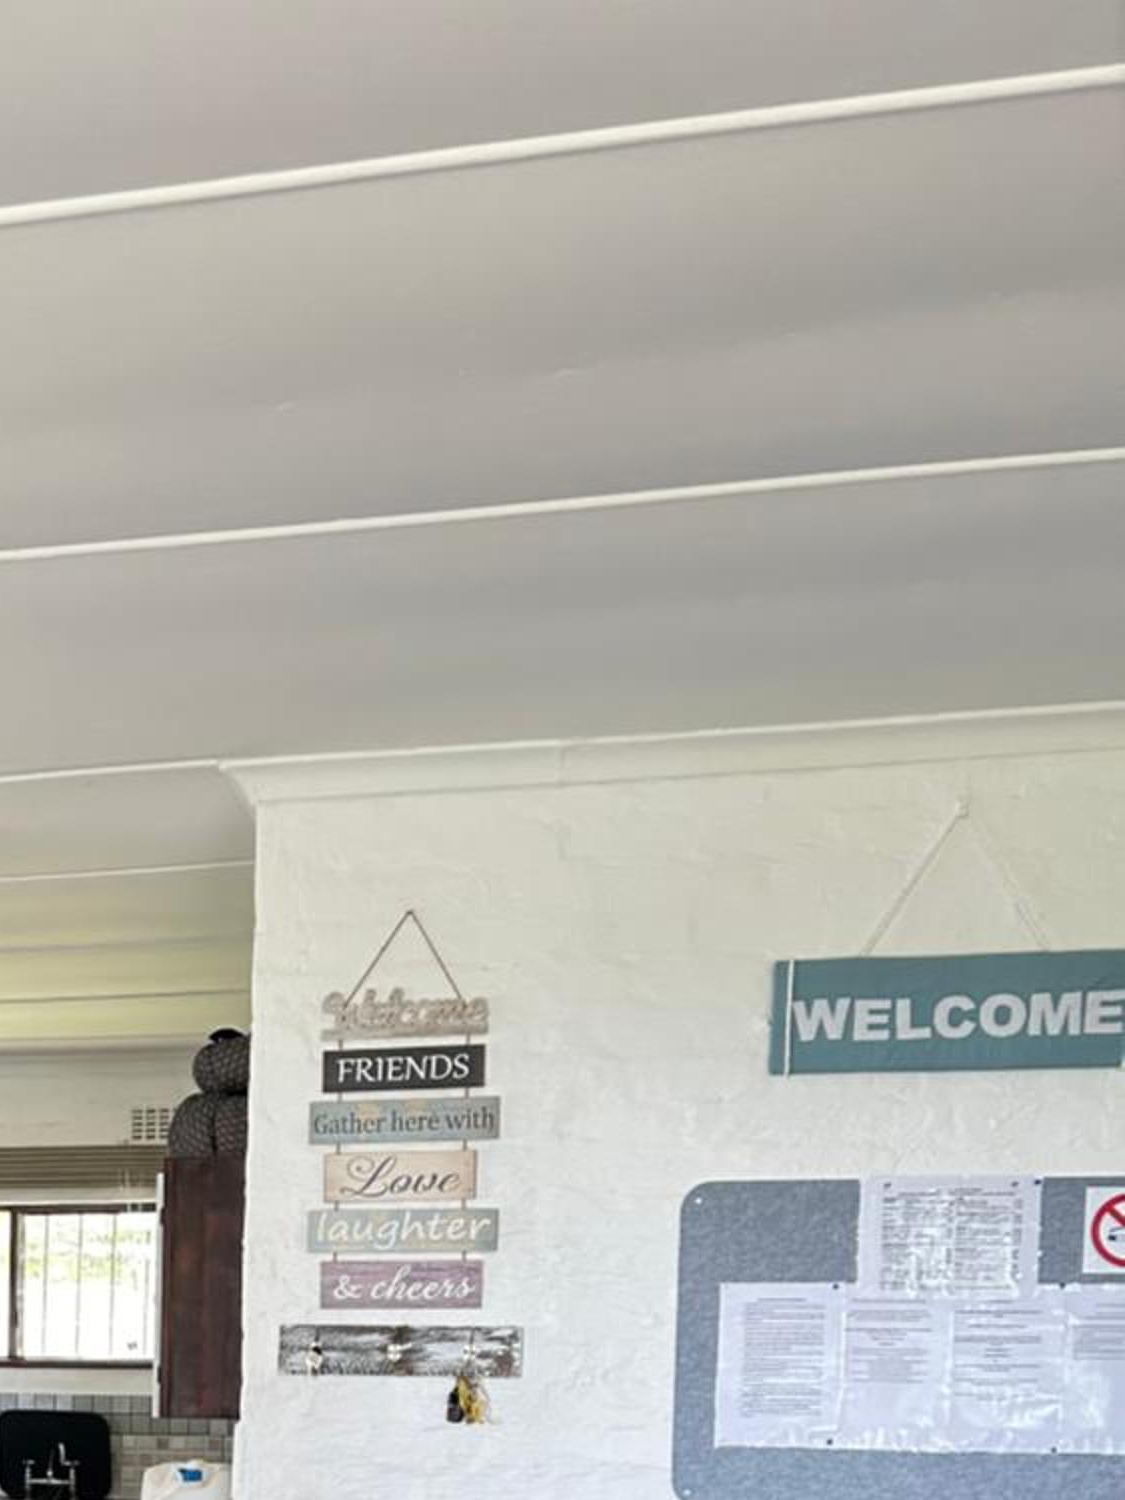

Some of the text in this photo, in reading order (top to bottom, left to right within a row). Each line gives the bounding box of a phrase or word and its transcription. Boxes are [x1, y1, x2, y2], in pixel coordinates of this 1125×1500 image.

[792, 988, 1125, 1042] WELCOME
[336, 1053, 470, 1084] FRIENDS
[313, 1106, 495, 1136] Gather here with
[339, 1154, 461, 1198] Love
[316, 1209, 492, 1250] laughter
[333, 1263, 476, 1301] & cheers
